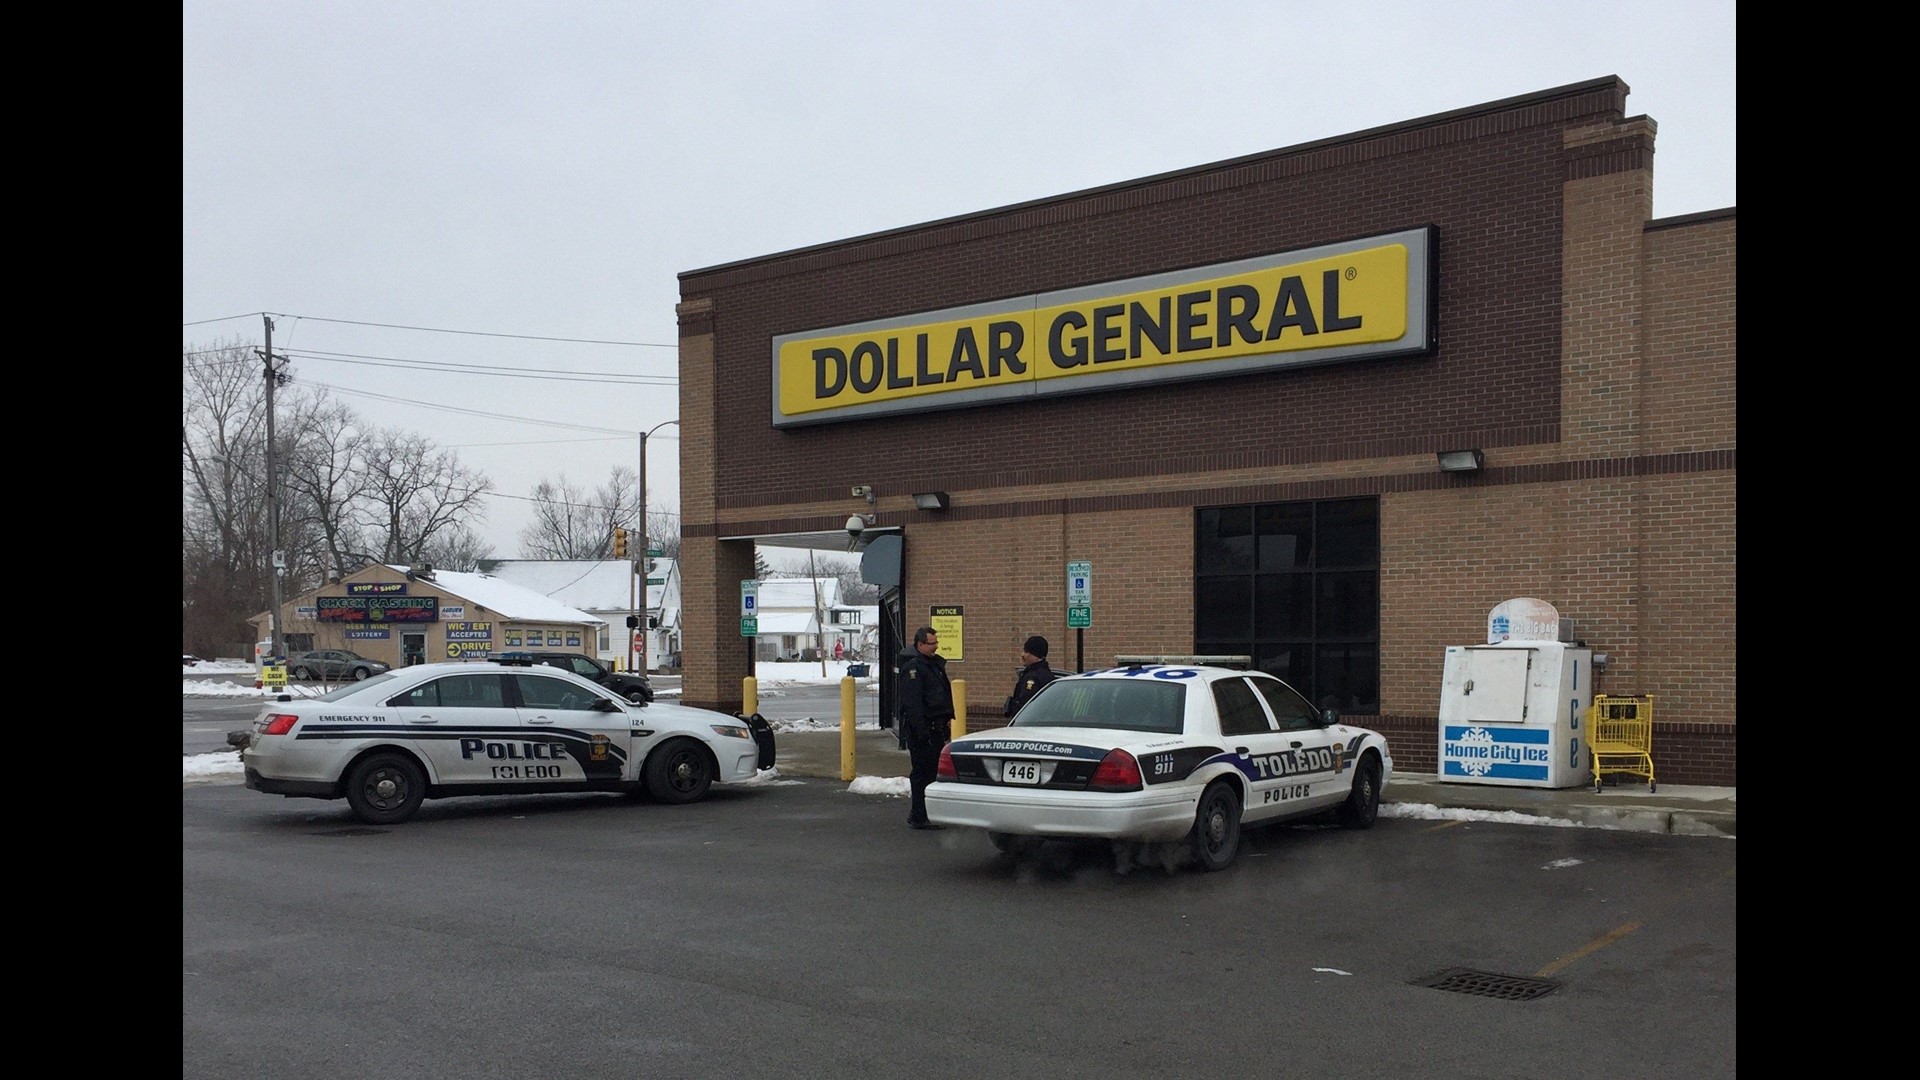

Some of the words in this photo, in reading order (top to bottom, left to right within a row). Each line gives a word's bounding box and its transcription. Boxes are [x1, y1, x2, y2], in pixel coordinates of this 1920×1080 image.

[812, 320, 1027, 399] DOLLAR
[319, 598, 366, 608] CHECK
[369, 598, 434, 609] CASHING
[1071, 609, 1088, 617] FINE
[743, 619, 756, 627] FINE
[461, 642, 492, 650] DRIVE
[1155, 753, 1174, 763] DIAL
[1445, 742, 1488, 759] Home
[1490, 744, 1521, 763] City
[1523, 746, 1548, 761] Ice
[1154, 761, 1174, 775] 911
[1251, 748, 1332, 778] TOLEDO
[491, 765, 562, 779] TOLEDO
[1008, 765, 1035, 780] 446
[1263, 784, 1310, 804] POLICE
